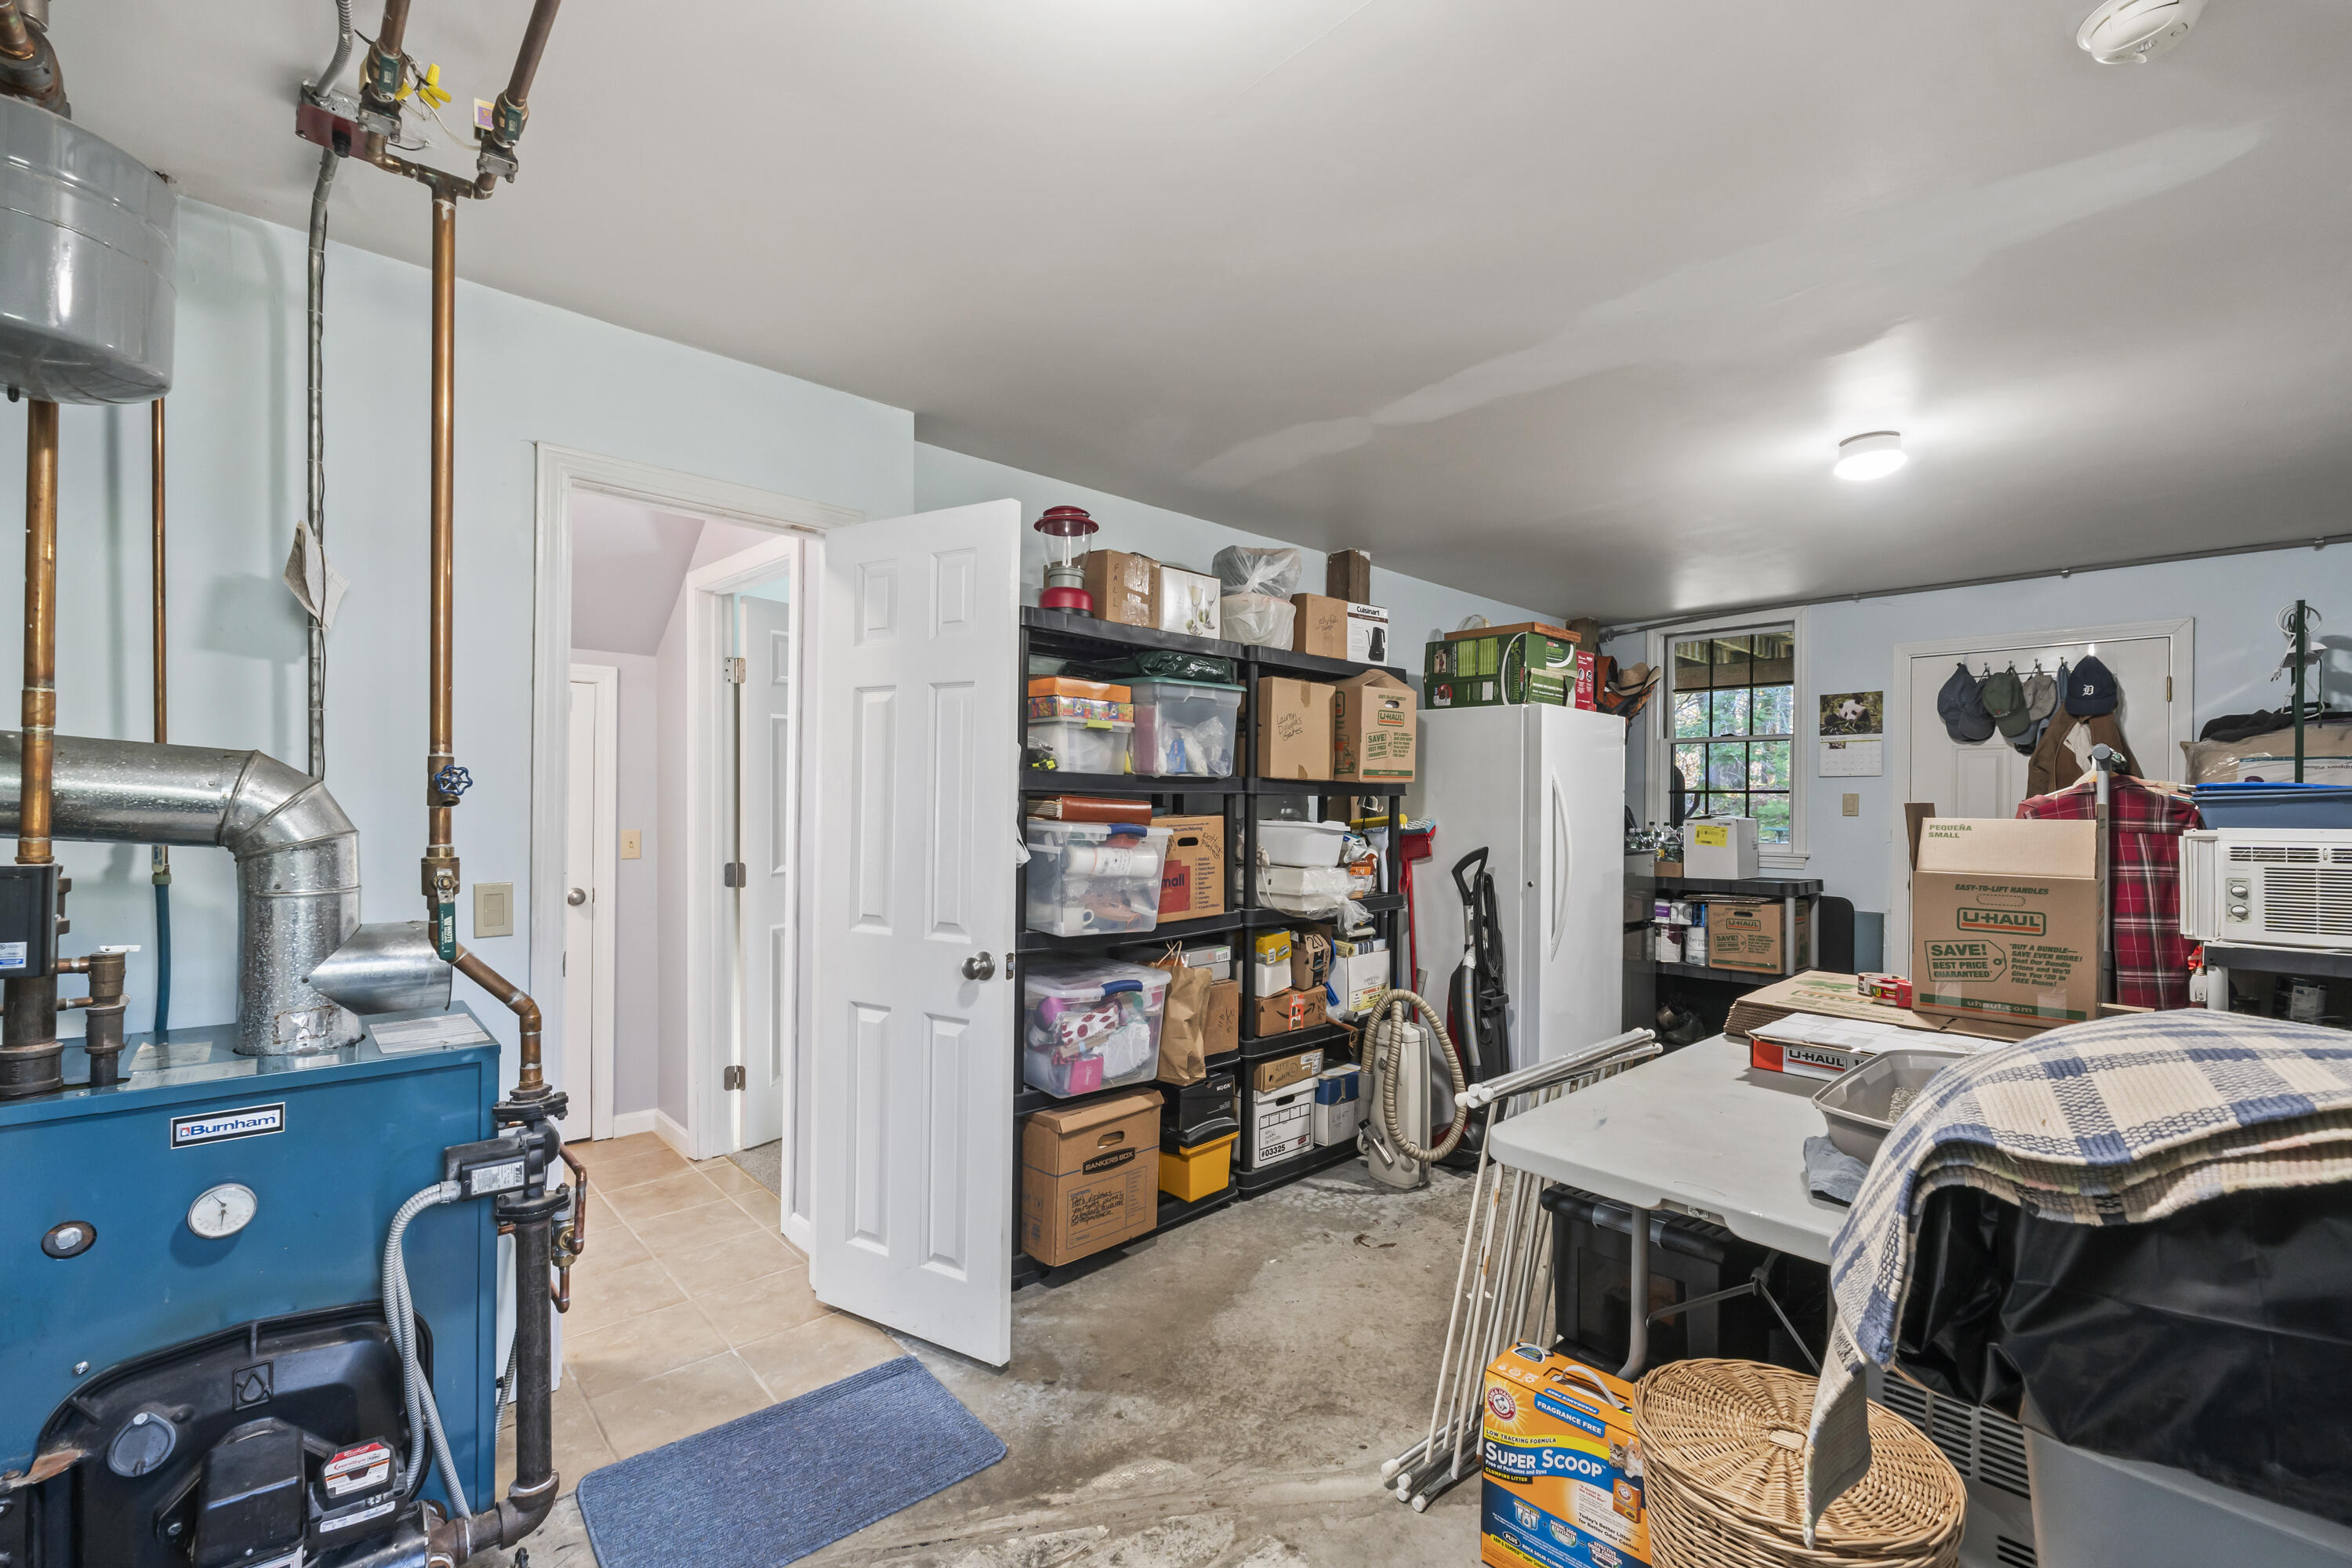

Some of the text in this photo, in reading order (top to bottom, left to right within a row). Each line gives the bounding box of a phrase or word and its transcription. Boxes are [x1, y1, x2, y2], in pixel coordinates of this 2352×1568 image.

[1356, 606, 1380, 616] Cuisinart
[2082, 684, 2094, 696] D
[1368, 734, 1387, 743] SAVE!
[1161, 873, 1185, 887] mall
[1955, 884, 2049, 895] EASY-TO-LIFT HANDLES
[1963, 911, 2040, 927] U-HAUL
[1306, 935, 1323, 949] 20
[1931, 944, 1987, 956] SAVE!
[1967, 1000, 2032, 1013] uhaul.com
[1788, 1049, 1845, 1067] U-HAUL
[191, 1116, 276, 1136] Burnham
[1261, 1144, 1286, 1158] #03325
[1085, 1151, 1134, 1171] BANKERS BOX
[1563, 1396, 1597, 1413] FRAGRANCE
[1537, 1401, 1602, 1435] FRAGRANCE FREE
[1501, 1434, 1529, 1444] TRACKING
[1485, 1442, 1536, 1469] SUPER
[1485, 1459, 1497, 1468] Free
[1503, 1465, 1525, 1475] Perfumes
[1485, 1467, 1511, 1479] CLUMPING
[1579, 1512, 1632, 1542] Today's Better Litter
[1587, 1523, 1603, 1534] Better
[1604, 1531, 1617, 1541] Odor
[1505, 1533, 1519, 1544] PLUS
[1522, 1543, 1534, 1554] ROCK
[1534, 1550, 1547, 1560] SOLID
[1588, 1542, 1623, 1565] ODOR CONTROL
[1594, 1541, 1617, 1556] EFFECTIVE
